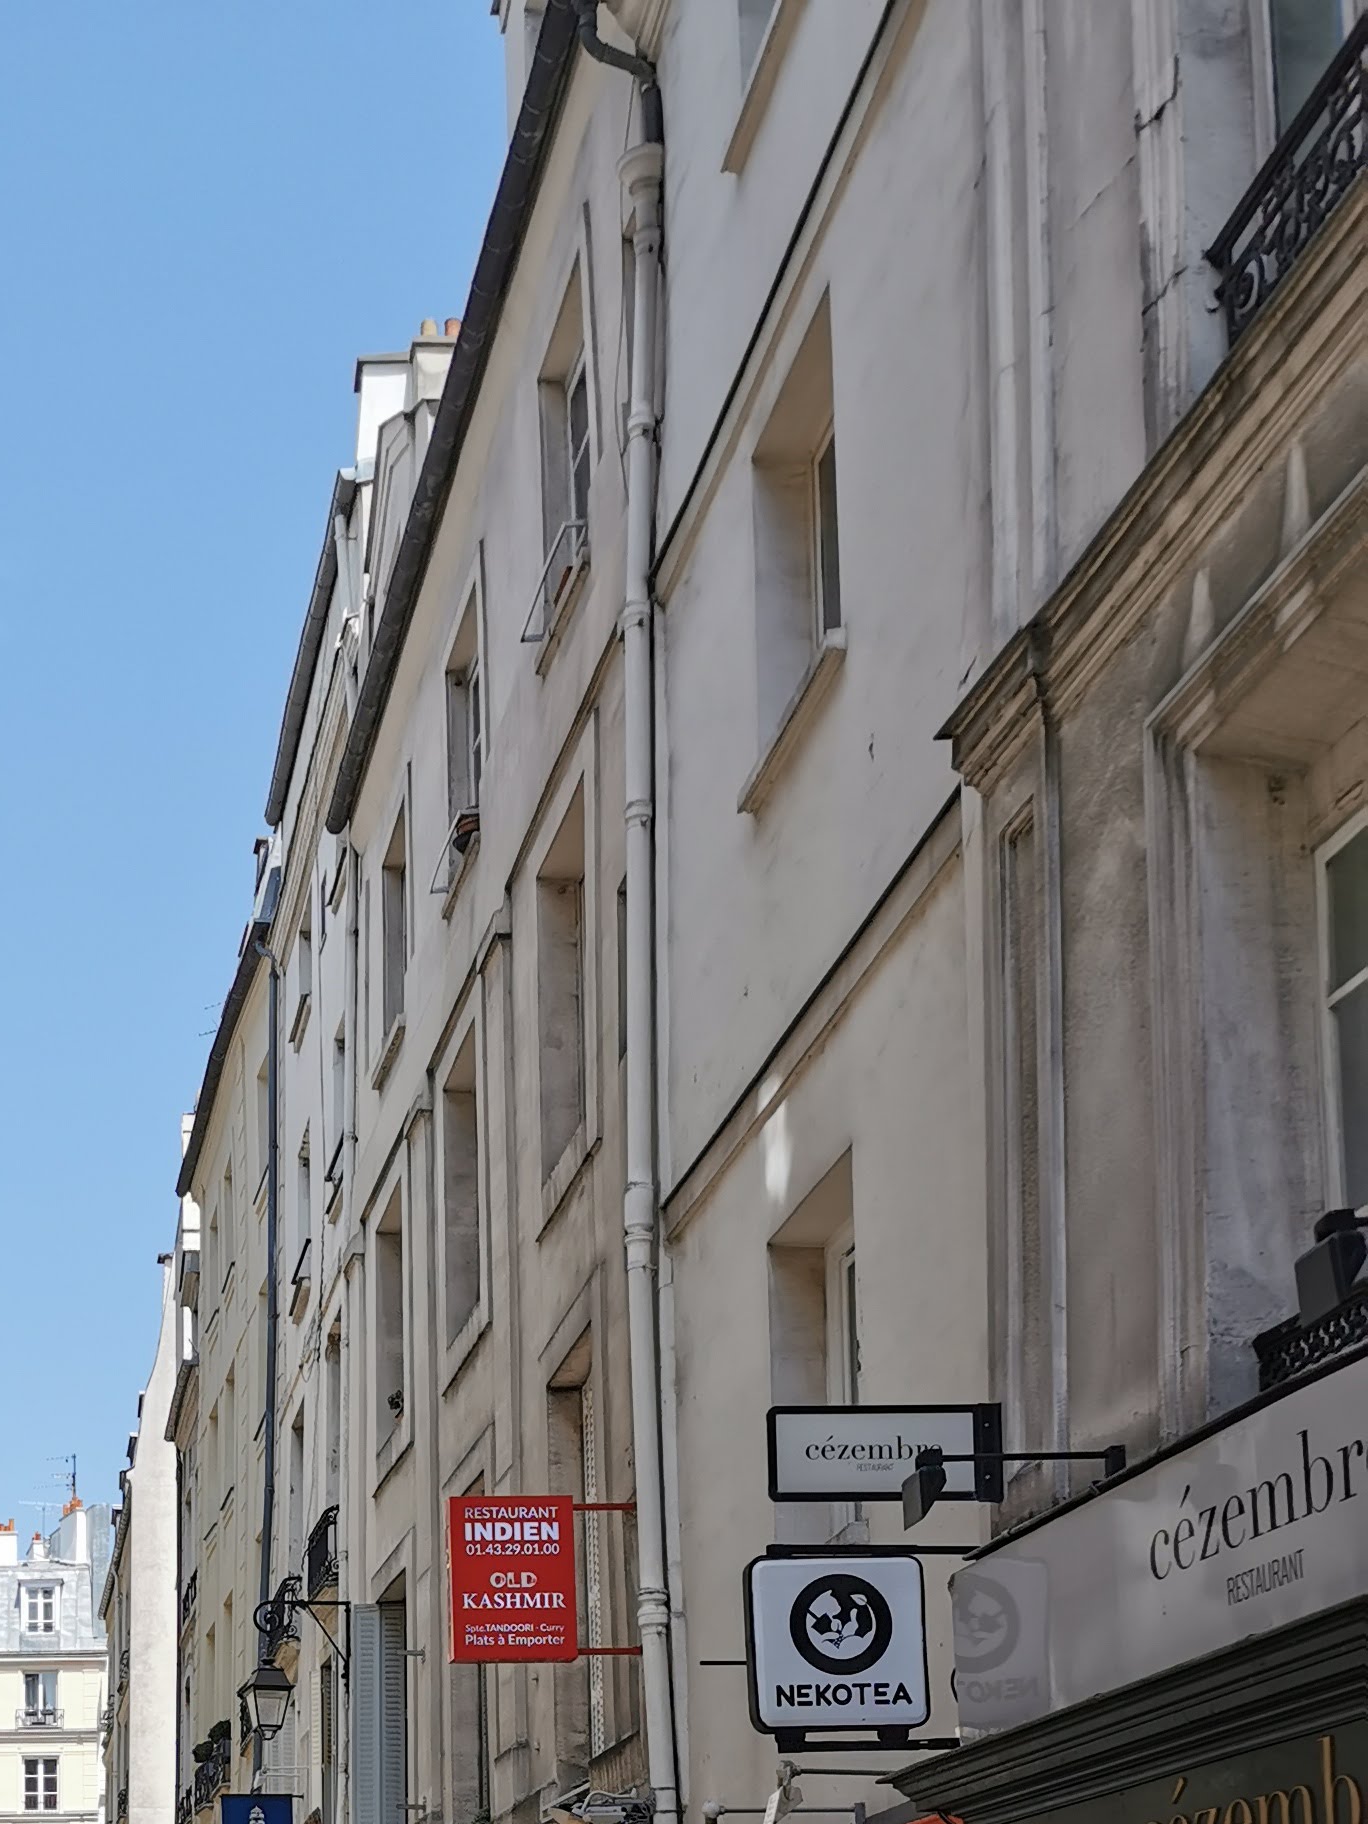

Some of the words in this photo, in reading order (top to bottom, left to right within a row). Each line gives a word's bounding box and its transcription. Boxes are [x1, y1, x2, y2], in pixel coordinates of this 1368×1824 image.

[464, 1506, 558, 1519] RESTAURANT
[1150, 1429, 1368, 1580] cézembr
[464, 1521, 560, 1541] INDIEN
[466, 1543, 560, 1555] 01.43.29.01.00
[490, 1571, 538, 1588] OLD
[1226, 1549, 1305, 1606] RESTAURANT
[462, 1592, 567, 1609] KASHMIR
[540, 1623, 564, 1634] Curry
[465, 1634, 495, 1646] Plats
[498, 1633, 505, 1646] à
[508, 1634, 565, 1647] Emporter
[775, 1682, 913, 1707] NEKOTEA
